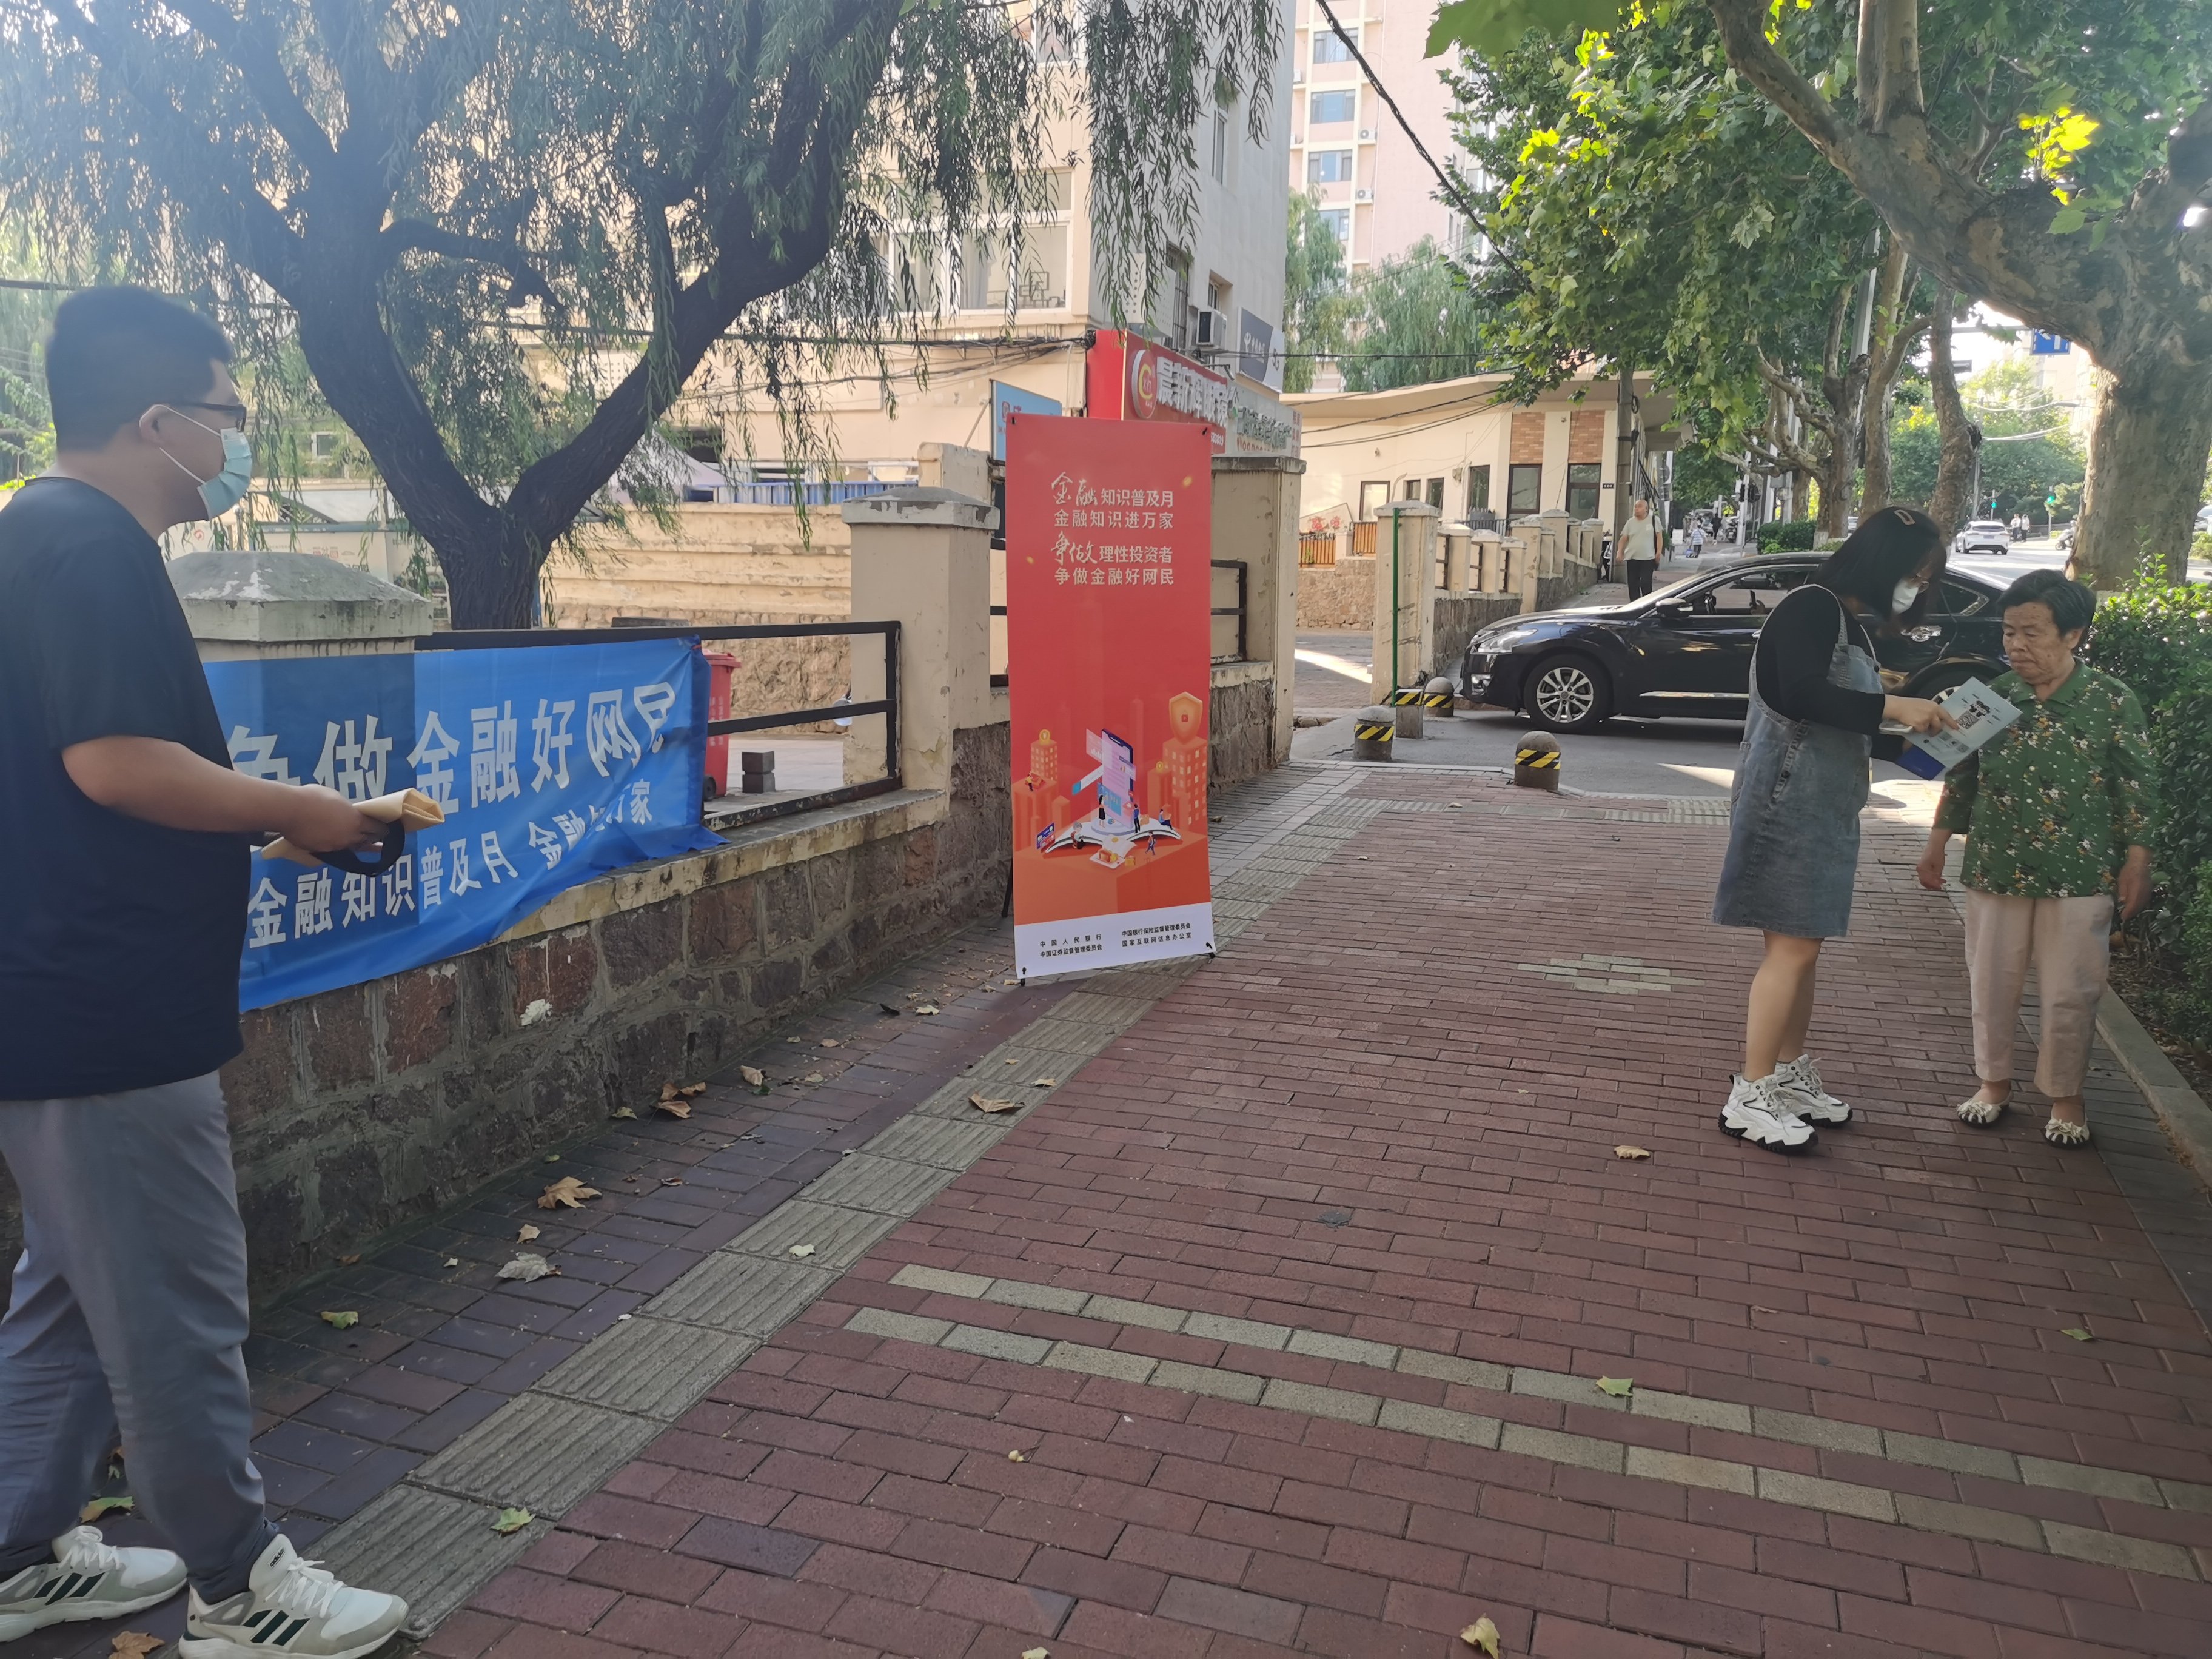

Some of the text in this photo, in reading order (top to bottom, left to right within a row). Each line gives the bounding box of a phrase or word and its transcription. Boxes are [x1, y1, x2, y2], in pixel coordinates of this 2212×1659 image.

[1051, 471, 1175, 508] 金融知识普及月
[1054, 509, 1175, 529] 金融知识进万家
[1050, 530, 1174, 566] 争做理性投资者
[1054, 567, 1175, 586] 争做金融好网民
[247, 830, 520, 949] 金融知识普及月
[1121, 922, 1191, 937] 中国银行保险监督管理委员会
[1122, 931, 1192, 947] 国家互联网信息办公室
[1039, 933, 1102, 948] 中国人民银行
[1039, 943, 1103, 958] 中国证券监督管理委员会
